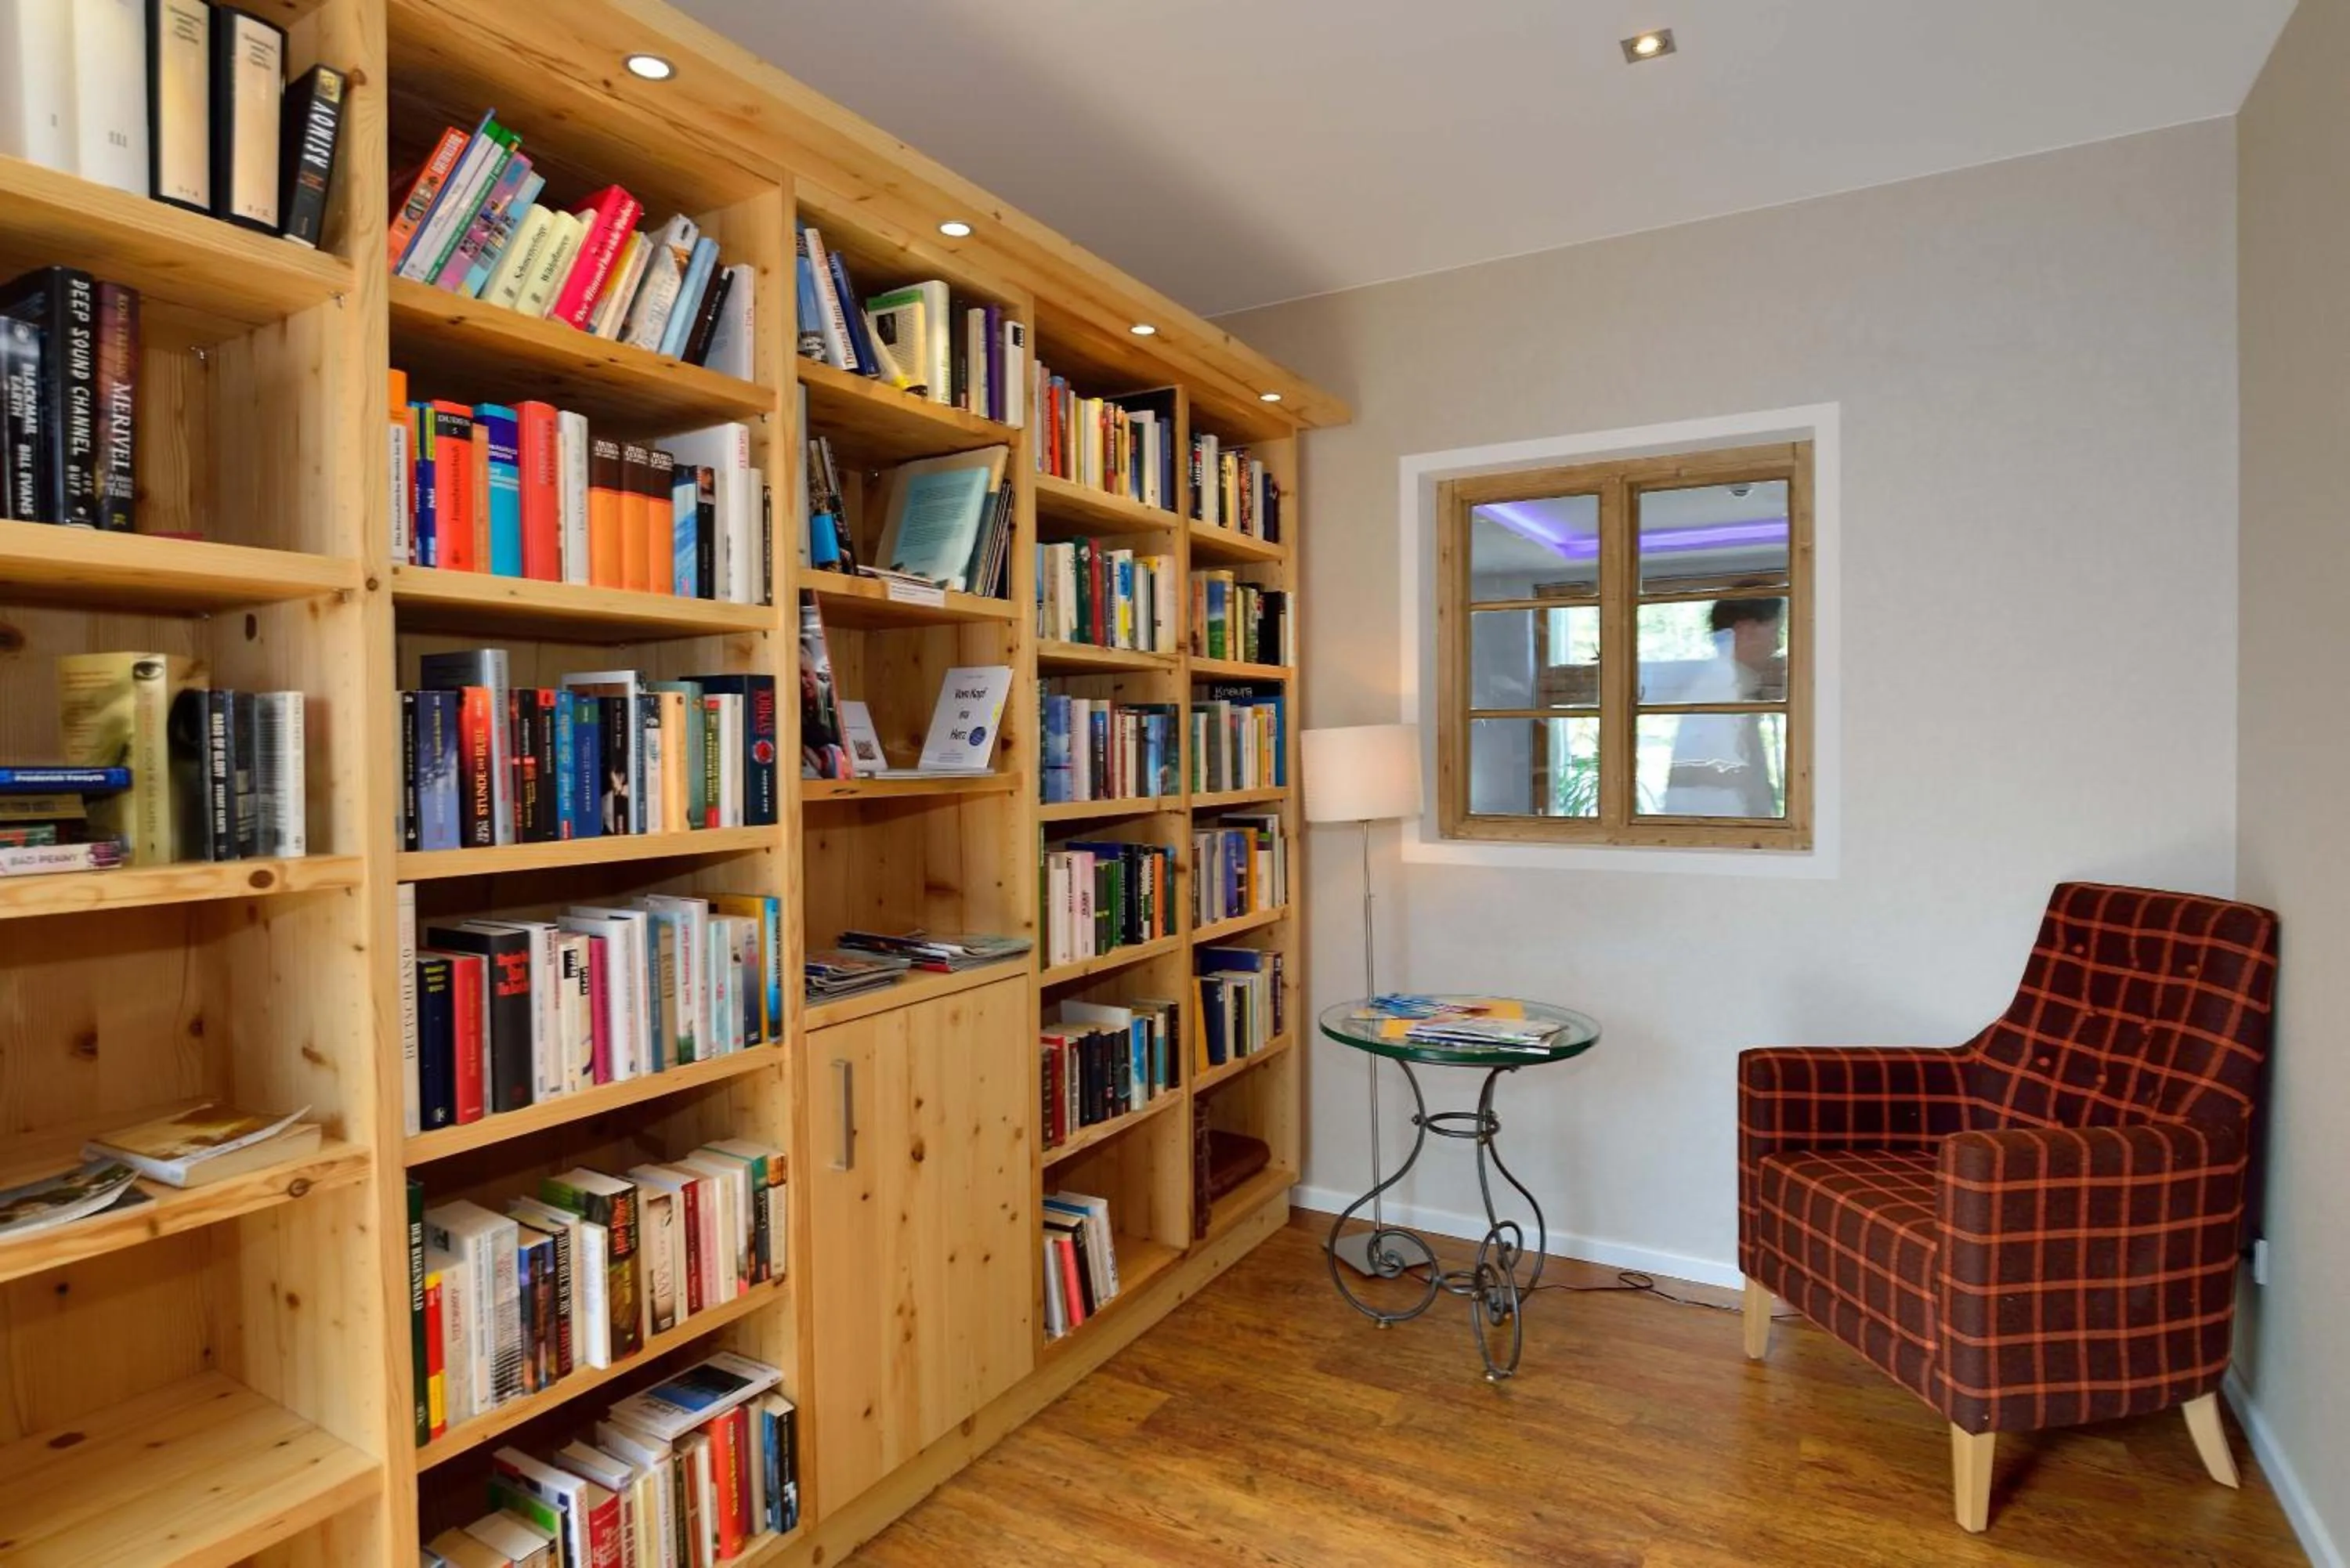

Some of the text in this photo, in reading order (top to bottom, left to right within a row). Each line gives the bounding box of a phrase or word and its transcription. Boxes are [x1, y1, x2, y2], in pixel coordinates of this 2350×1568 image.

[302, 100, 337, 169] ASIMOV
[9, 374, 24, 417] EARTH
[21, 363, 38, 435] BLACKMAIL
[68, 278, 92, 457] DEEP SOUND CHANNEL
[110, 381, 133, 470] MERIVEL
[18, 443, 34, 516] BILL EVANS
[475, 771, 489, 816] STUNDE
[411, 1222, 424, 1311] DER REGENWALD
